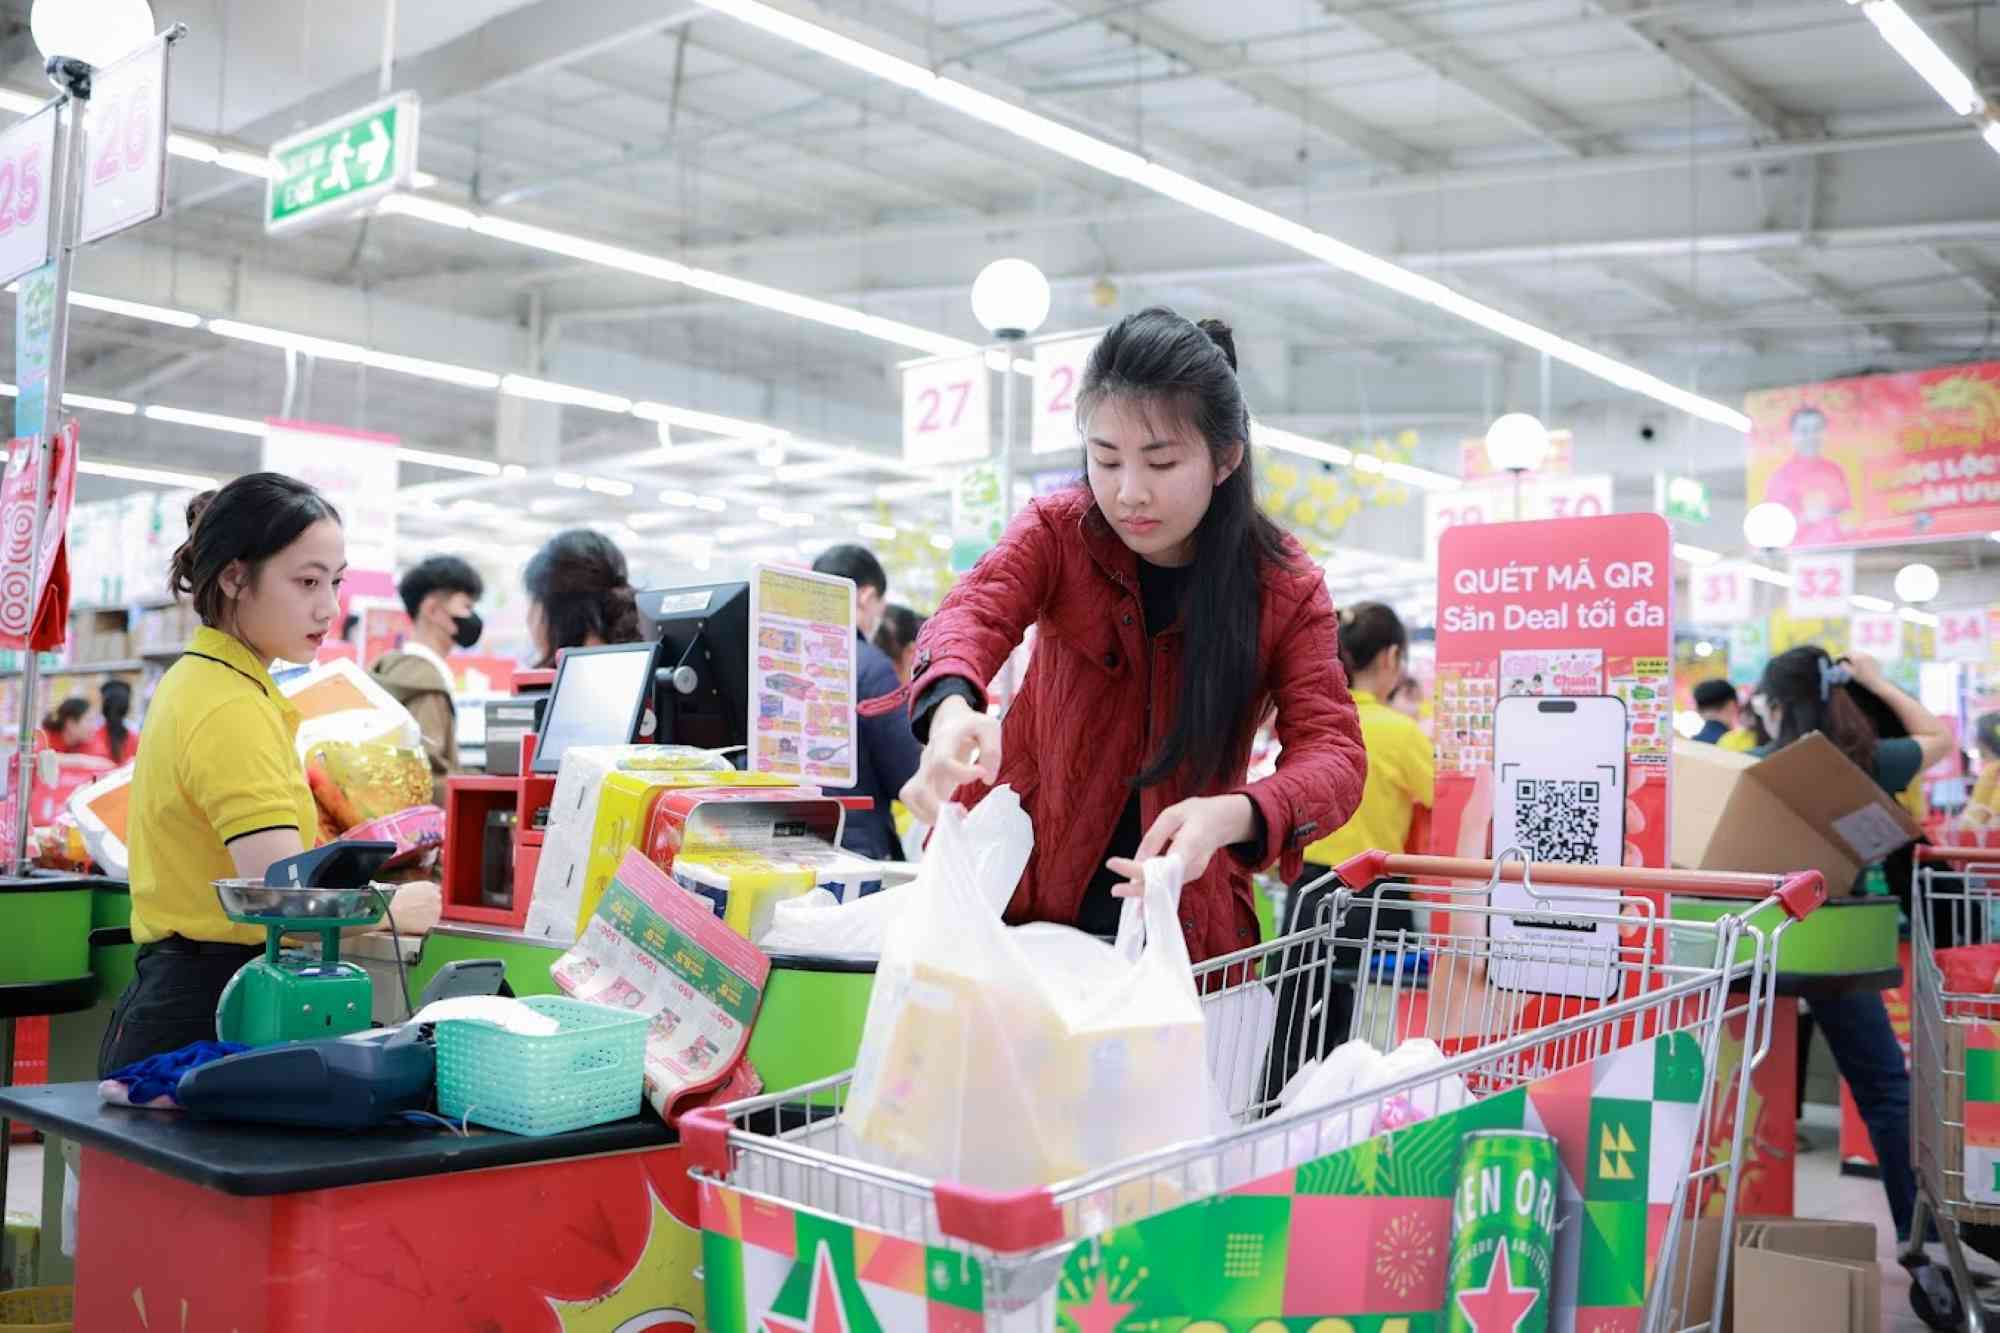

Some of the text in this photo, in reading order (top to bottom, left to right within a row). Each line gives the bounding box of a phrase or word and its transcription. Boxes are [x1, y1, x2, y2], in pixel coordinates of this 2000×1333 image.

[915, 380, 973, 432] 27
[1048, 365, 1074, 413] 2
[1454, 558, 1654, 595] QUÉT MÃ QR
[1799, 567, 1842, 597] 32
[1443, 597, 1665, 632] Săn Deal tối đa
